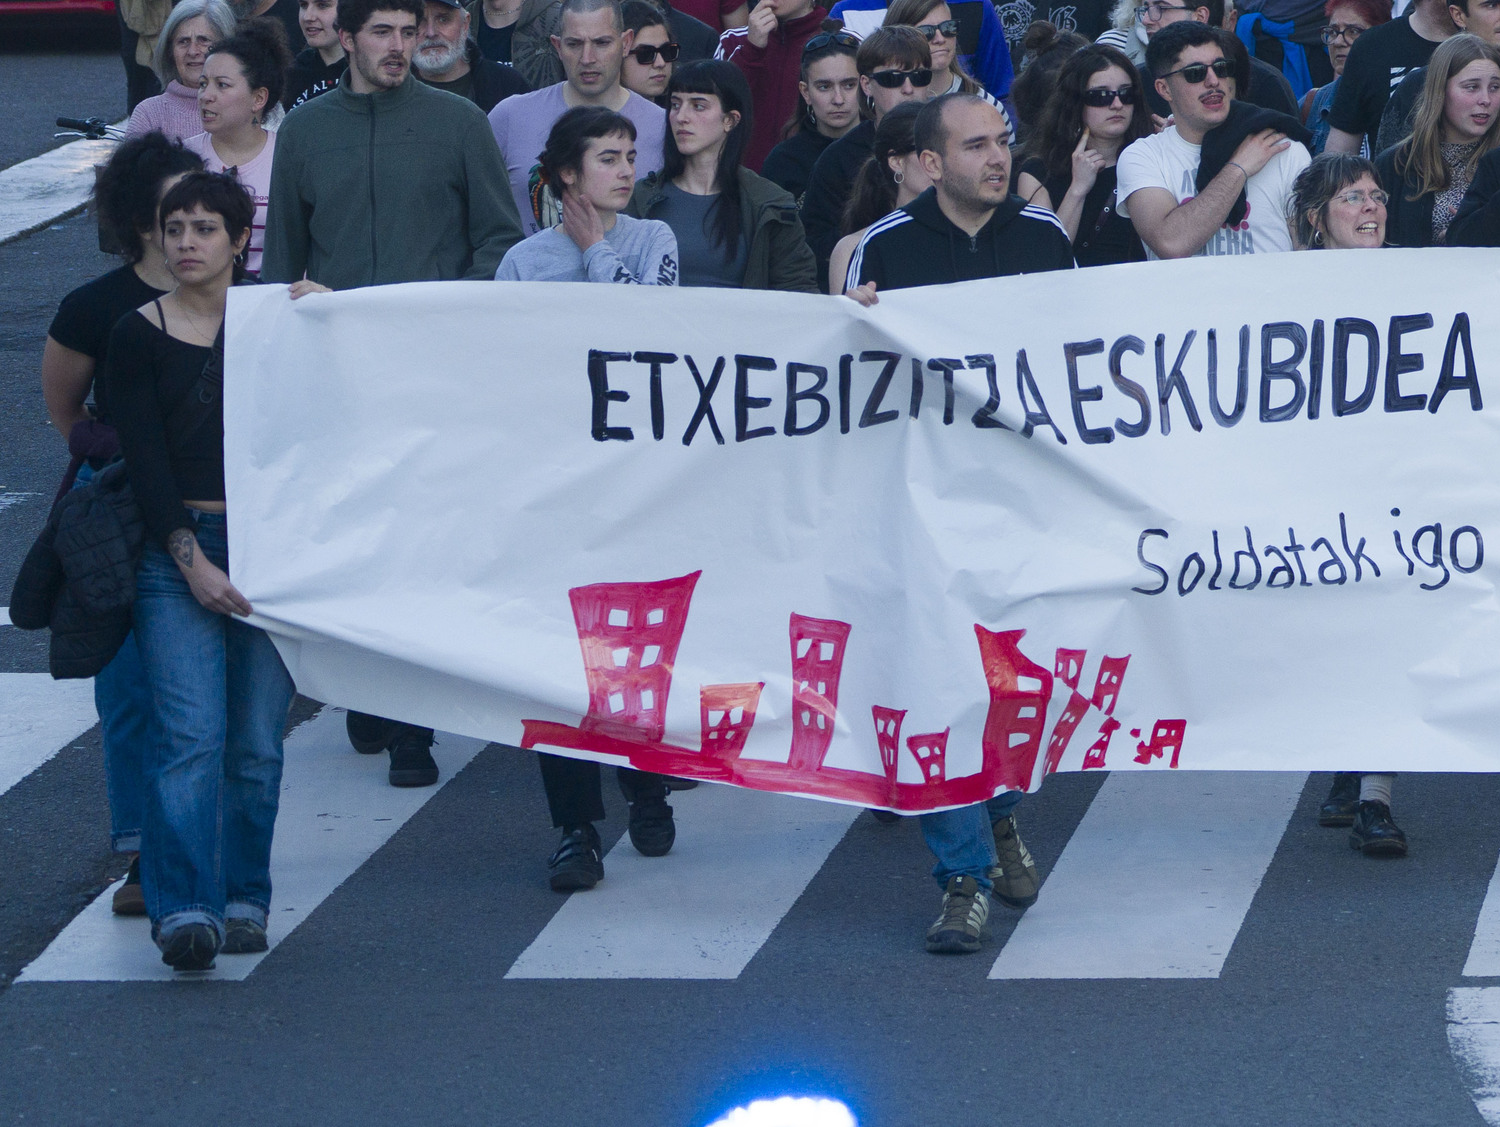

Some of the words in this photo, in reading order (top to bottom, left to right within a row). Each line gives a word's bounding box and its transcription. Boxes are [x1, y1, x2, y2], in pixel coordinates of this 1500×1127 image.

[587, 348, 1068, 446] ETXEBIZITZA
[1064, 312, 1484, 446] ESKUBIDEA
[1132, 512, 1381, 597] Soldatak
[1390, 507, 1485, 591] igo
